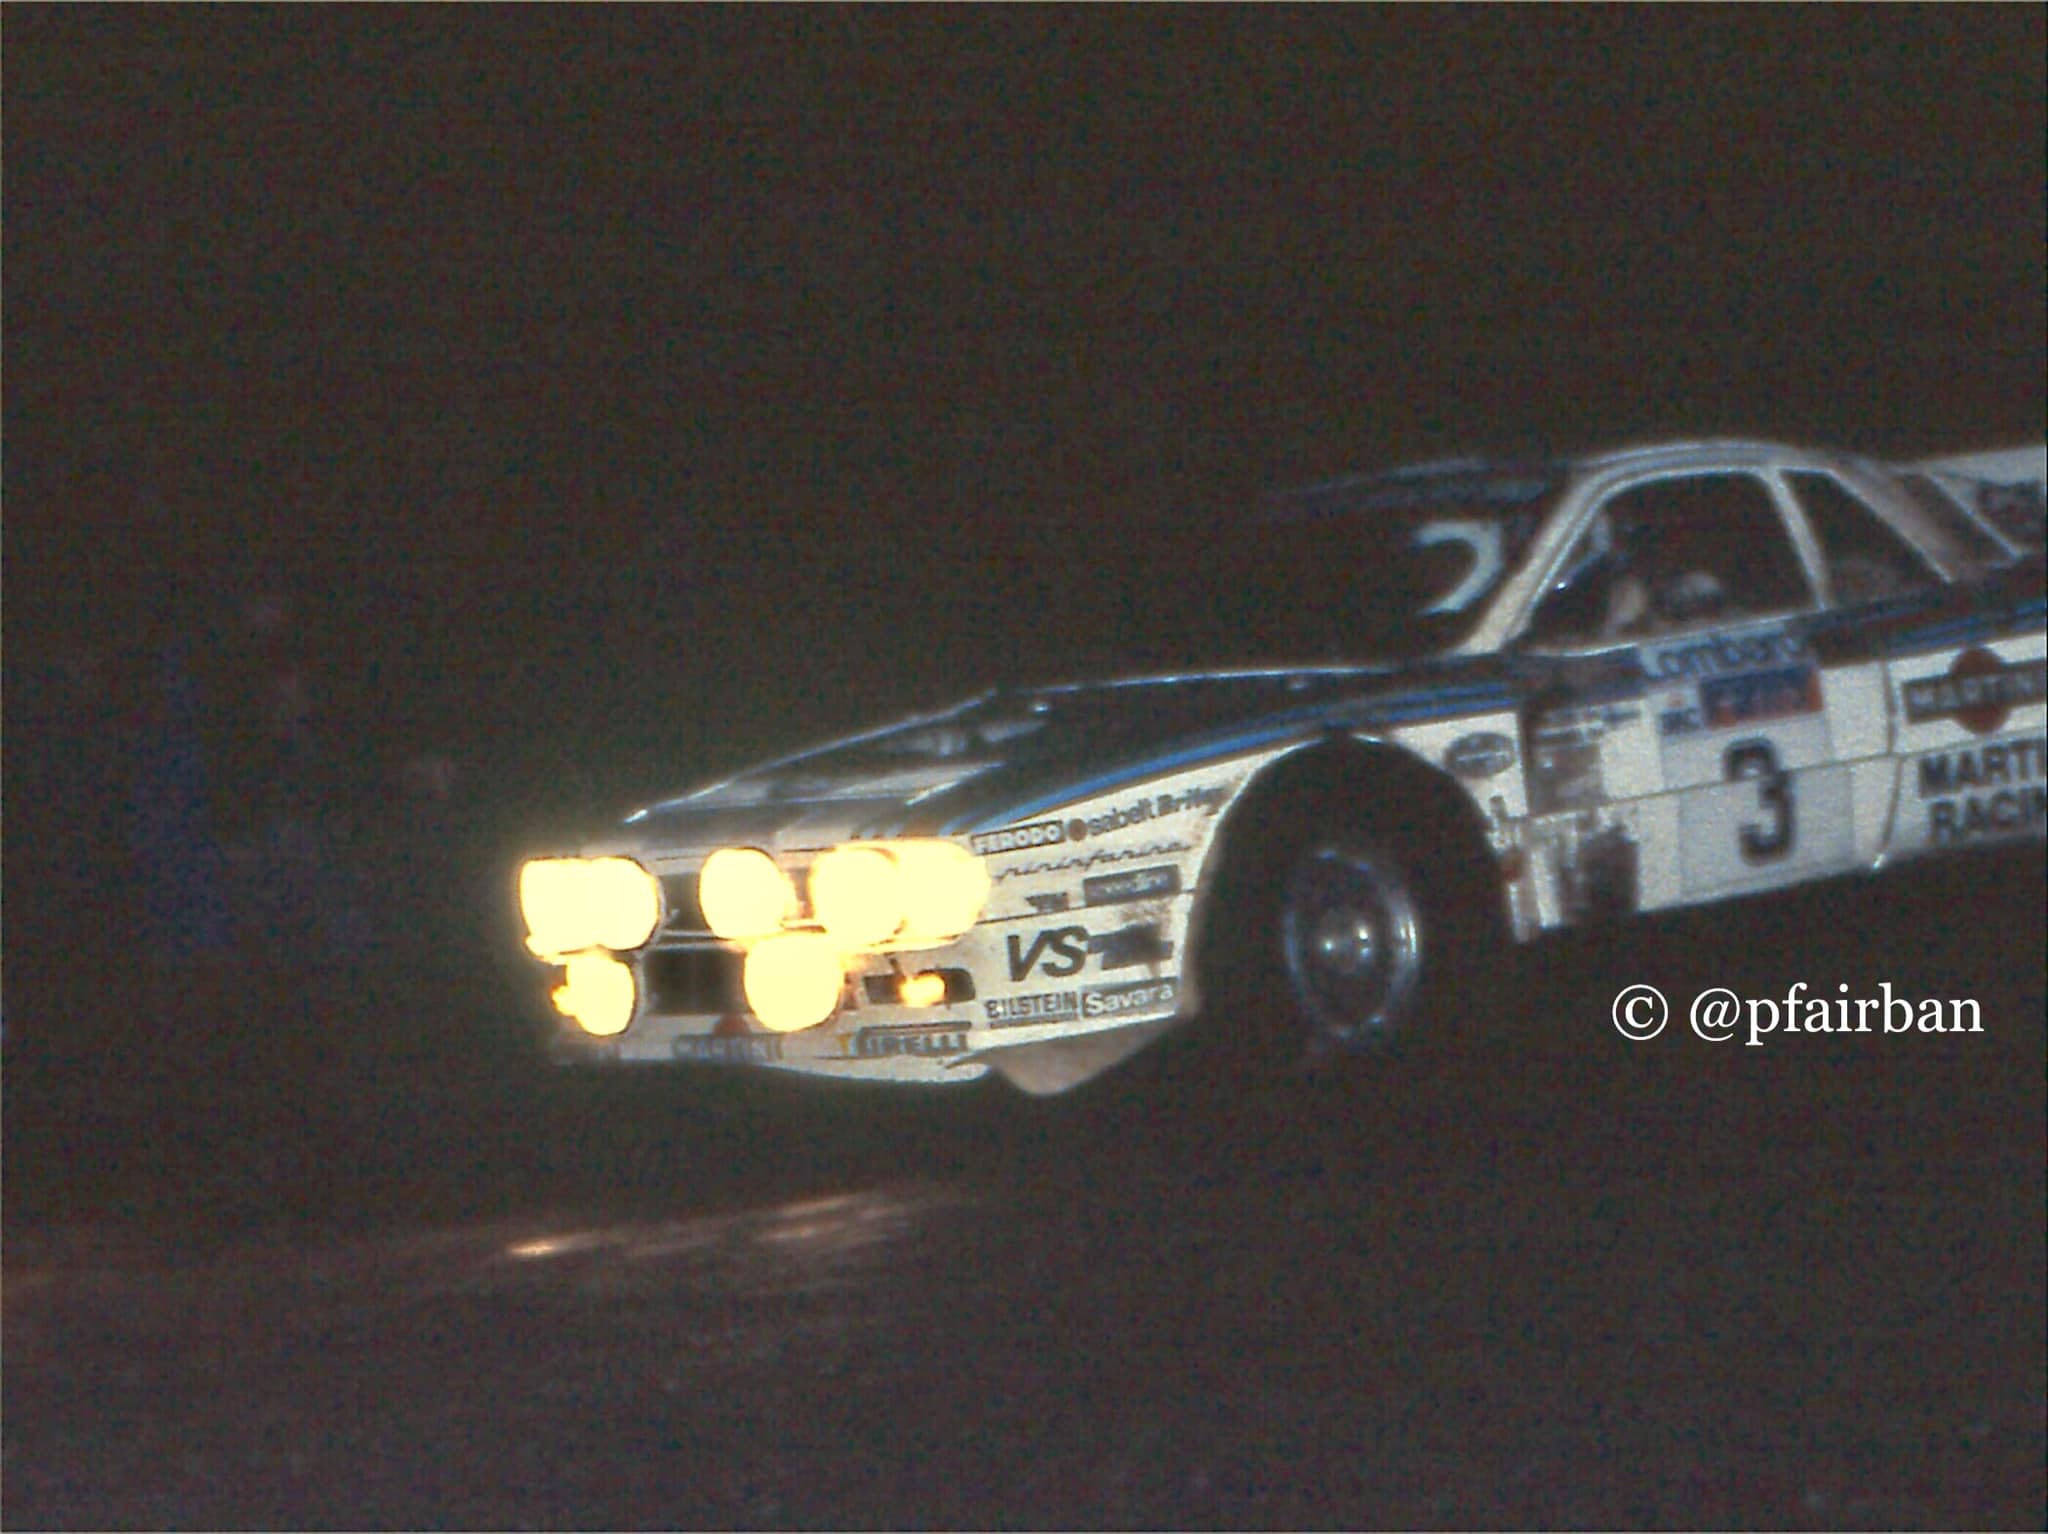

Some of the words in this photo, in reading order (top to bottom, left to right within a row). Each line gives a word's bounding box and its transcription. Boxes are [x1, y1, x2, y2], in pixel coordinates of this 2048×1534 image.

[1722, 734, 1796, 866] 3
[1006, 924, 1090, 983] VS
[984, 990, 1078, 1020] BILSTEIN
[1084, 983, 1174, 1015] Savara
